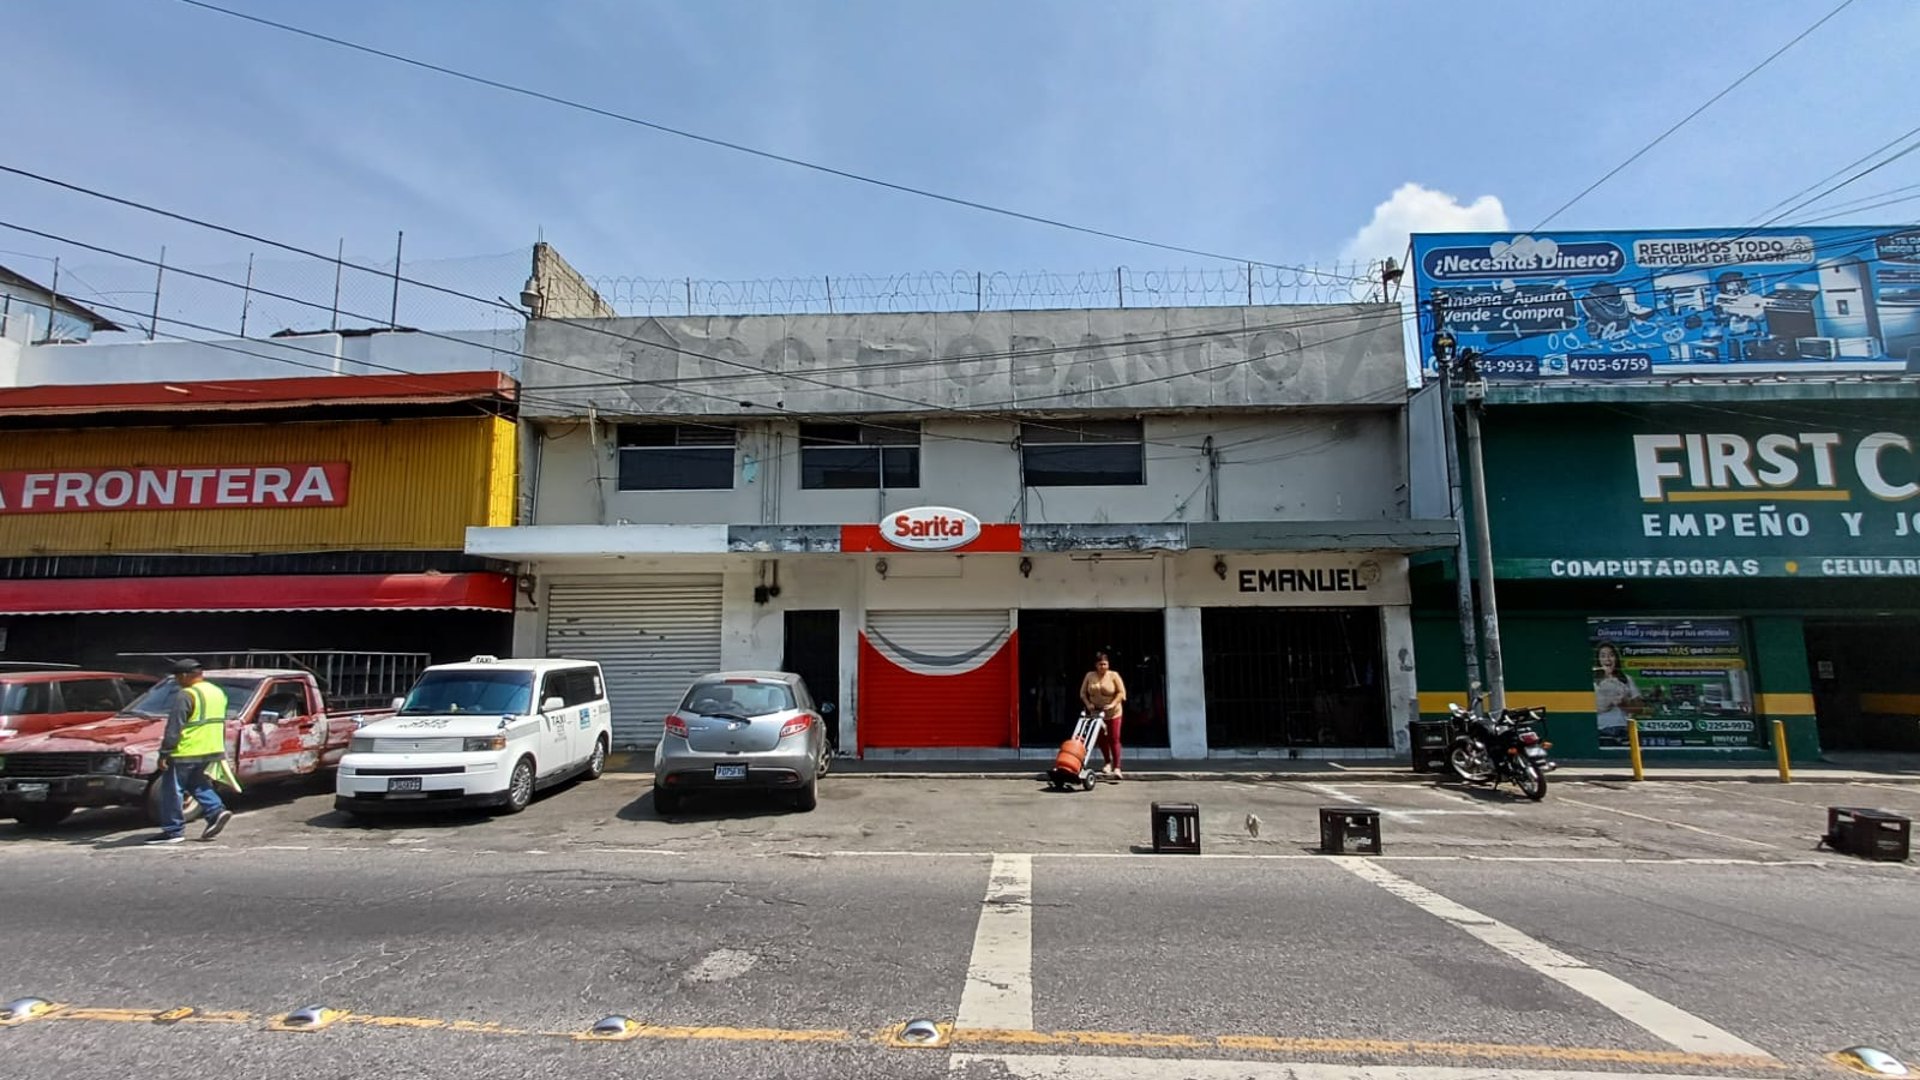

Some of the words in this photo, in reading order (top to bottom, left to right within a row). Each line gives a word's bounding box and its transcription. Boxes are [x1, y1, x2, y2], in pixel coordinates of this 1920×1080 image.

[1639, 242, 1731, 256] RECIBIMOS
[1733, 240, 1784, 254] TODO
[1541, 250, 1619, 269] Dinero?
[1713, 254, 1728, 264] DE
[1443, 307, 1491, 323] Vende
[1502, 306, 1565, 322] Compra
[1570, 358, 1649, 372] 4705-6759
[1633, 433, 1841, 500] FIRST
[21, 467, 335, 509] FRONTERA
[894, 515, 964, 537] Sarita
[1643, 505, 1811, 537] EMPEÑO
[1841, 512, 1864, 536] Y
[1550, 558, 1760, 577] COMPUTADORAS
[1238, 569, 1368, 592] EMANUEL
[551, 714, 567, 727] TAXI
